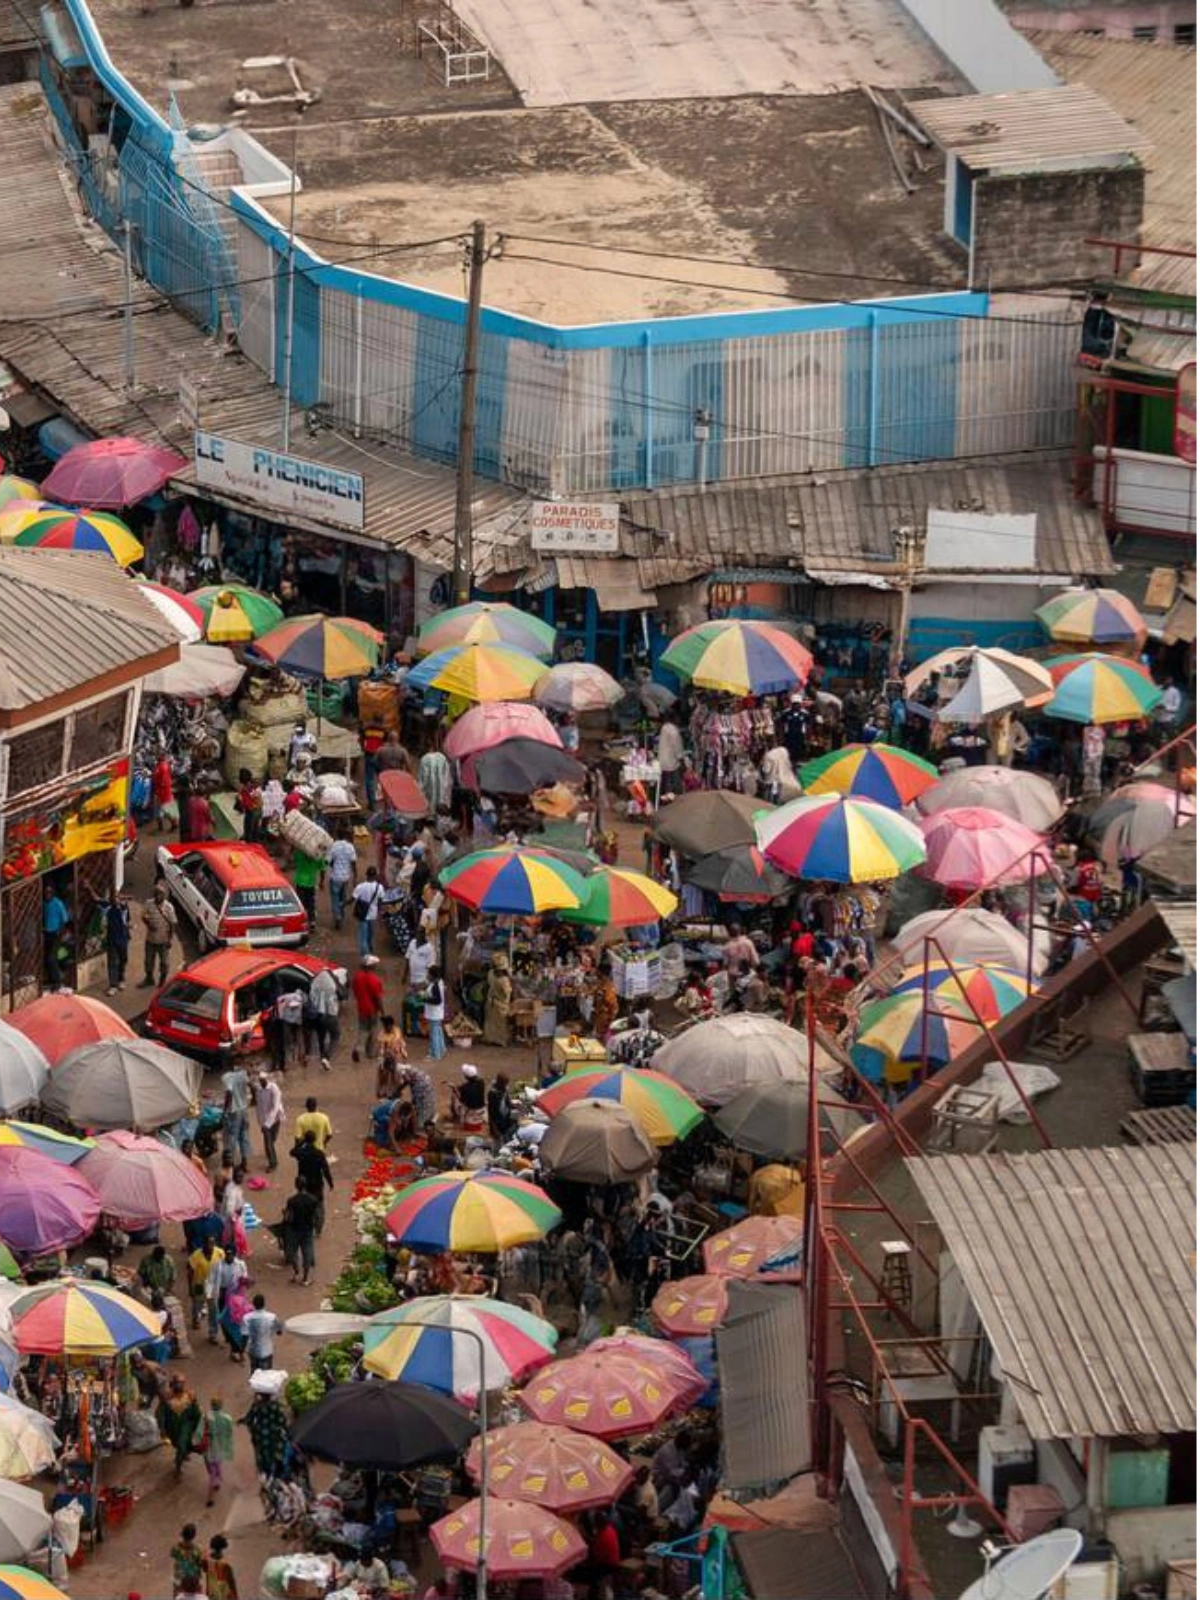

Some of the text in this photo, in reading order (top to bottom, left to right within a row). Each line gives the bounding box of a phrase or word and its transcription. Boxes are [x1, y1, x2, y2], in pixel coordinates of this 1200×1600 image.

[196, 434, 225, 463] LE
[253, 451, 361, 502] PHENICIEN
[542, 505, 602, 518] PARADIS
[534, 517, 616, 531] COSMETIQUES
[241, 889, 285, 902] TOYOTA
